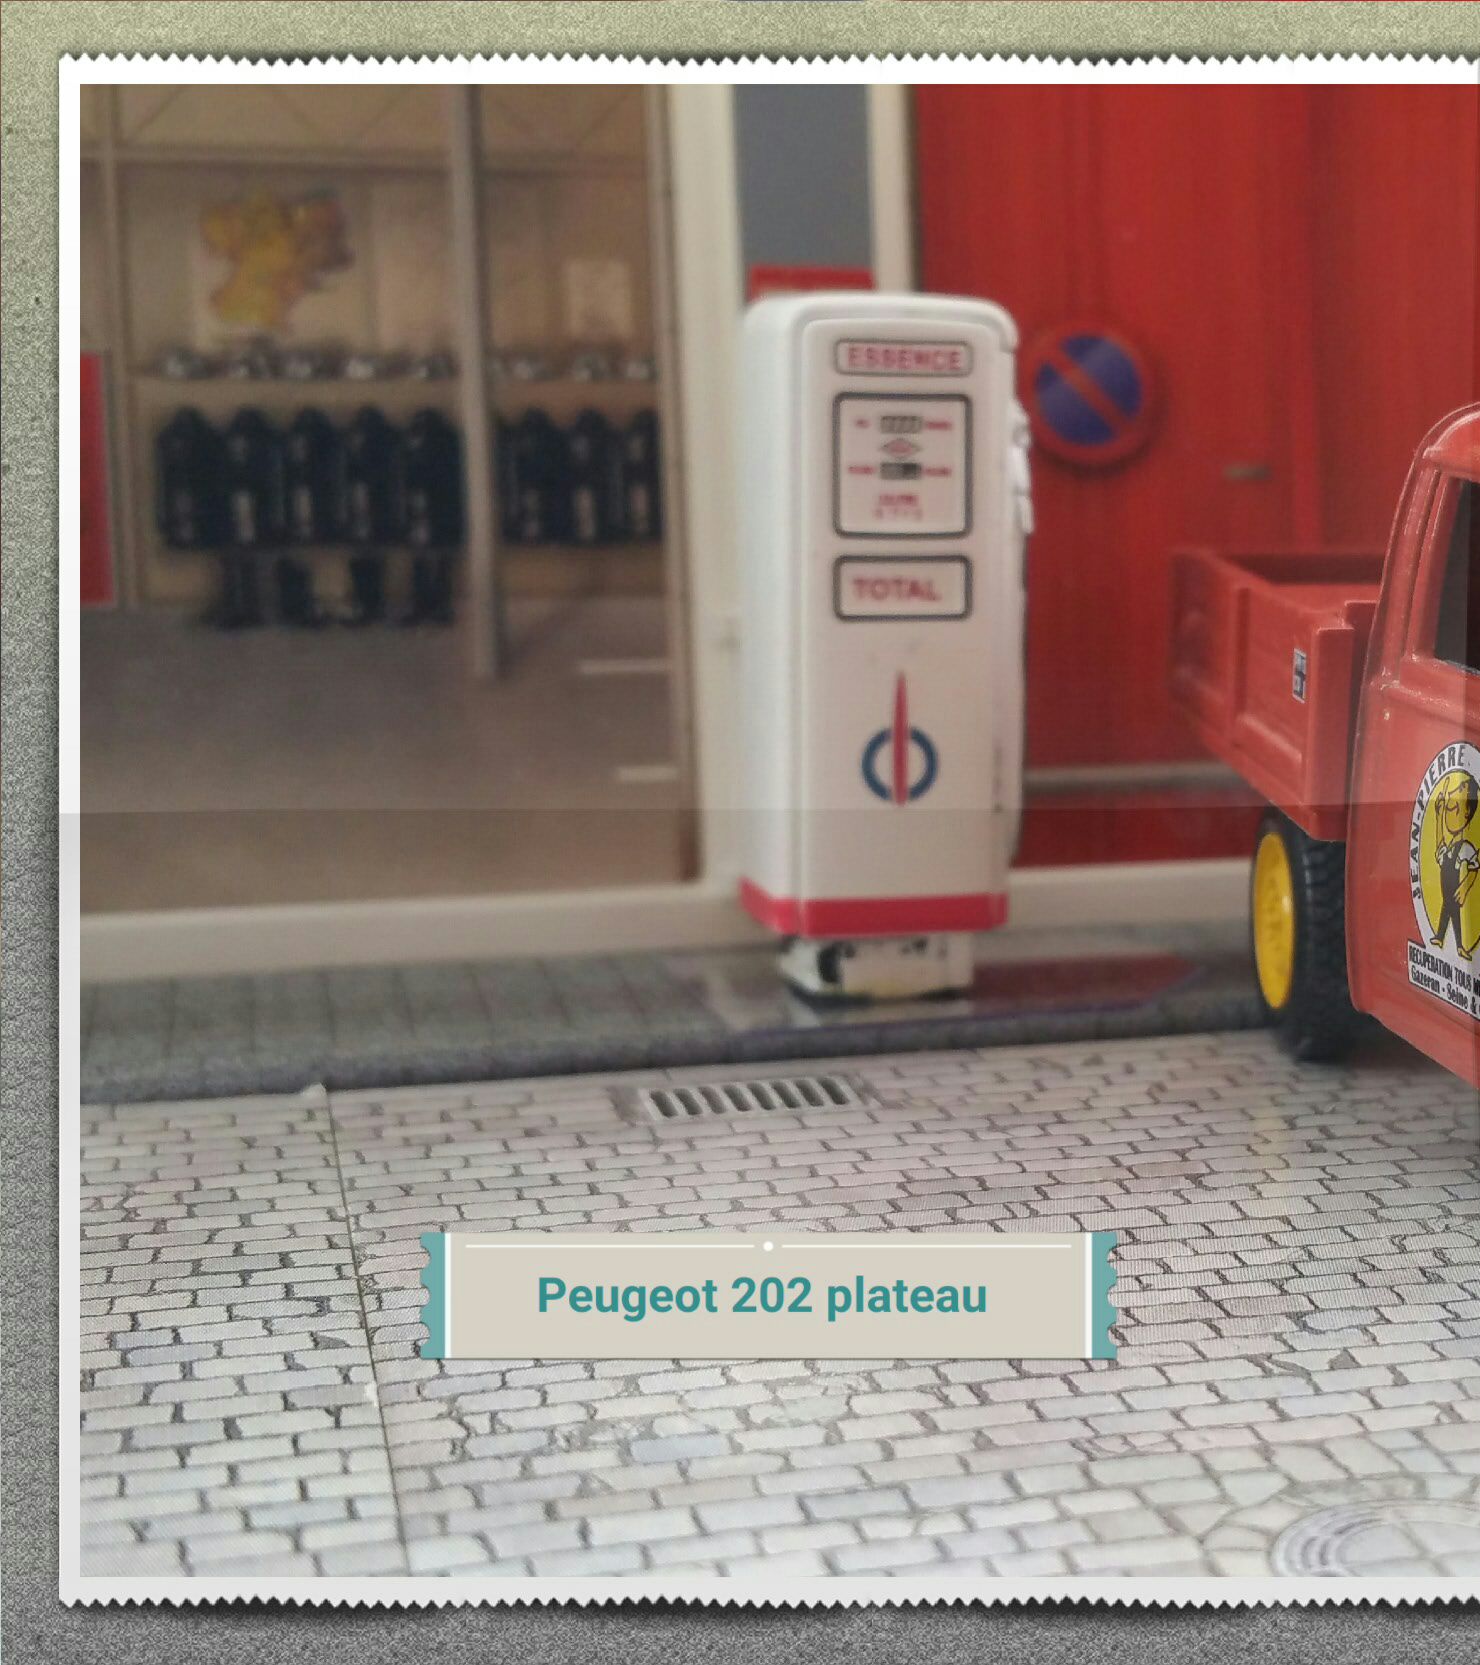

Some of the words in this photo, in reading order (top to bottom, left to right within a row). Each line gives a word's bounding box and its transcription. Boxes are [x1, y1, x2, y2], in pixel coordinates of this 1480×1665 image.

[847, 346, 961, 371] ESSENCE
[852, 577, 942, 601] TOTAL
[1409, 945, 1453, 982] RECUPERATION
[1454, 966, 1472, 992] TOUS
[1411, 964, 1440, 993] Gazeran
[1446, 982, 1468, 1009] Seine
